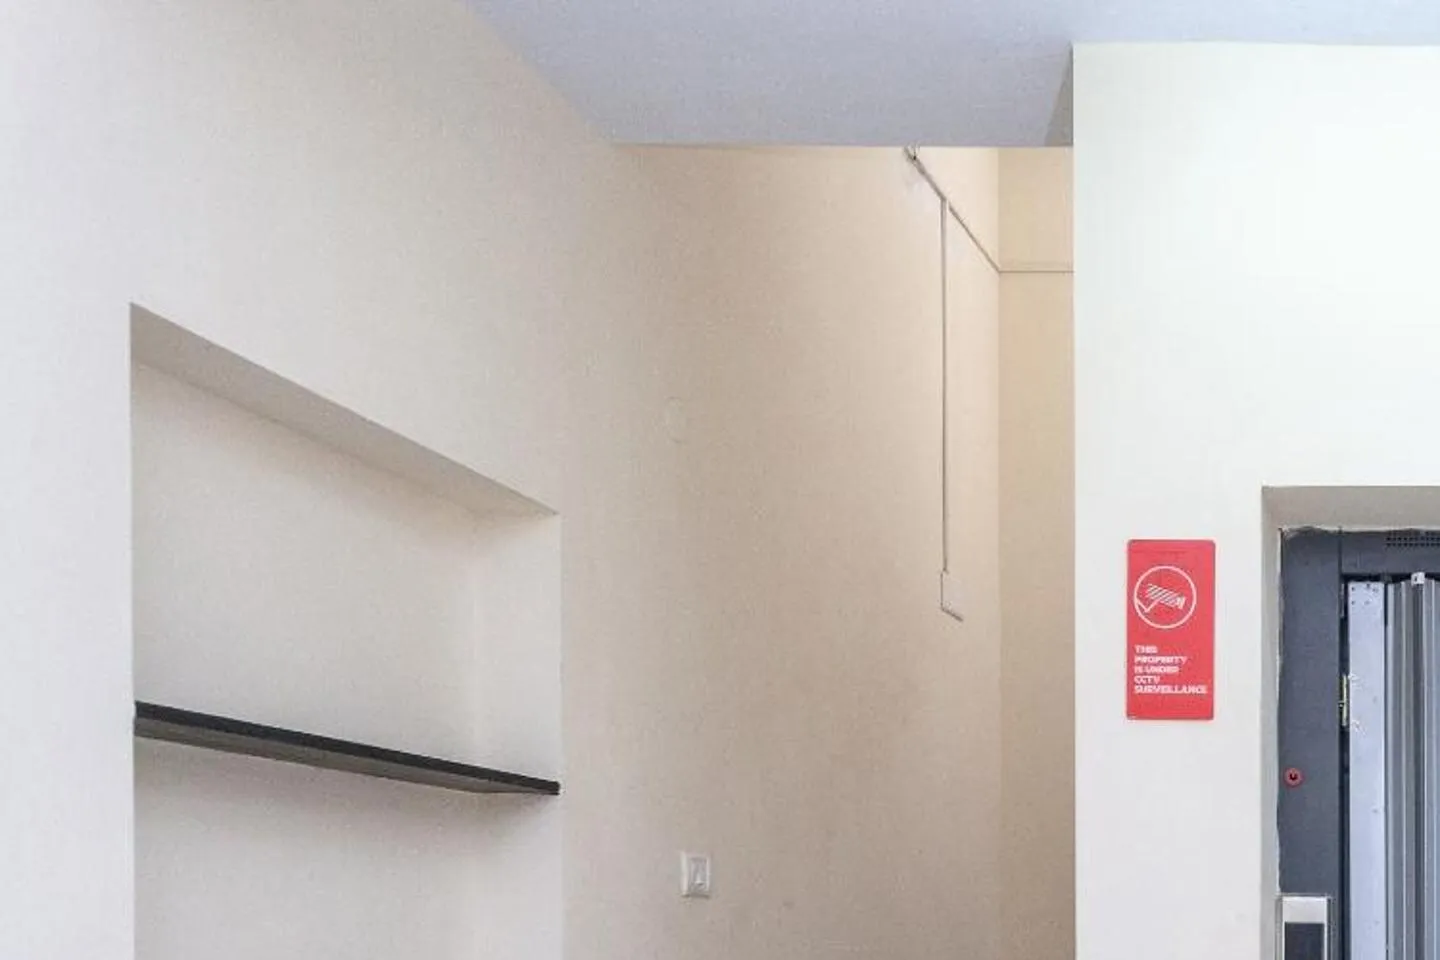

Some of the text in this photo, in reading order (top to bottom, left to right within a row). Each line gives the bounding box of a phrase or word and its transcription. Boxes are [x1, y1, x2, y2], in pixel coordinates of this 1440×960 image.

[1134, 644, 1158, 654] THIS
[1134, 655, 1187, 665] PROPERTY
[1134, 665, 1180, 674] IS UNDER
[1134, 675, 1160, 685] CCTV
[1134, 684, 1208, 694] SURVEILLANCE
